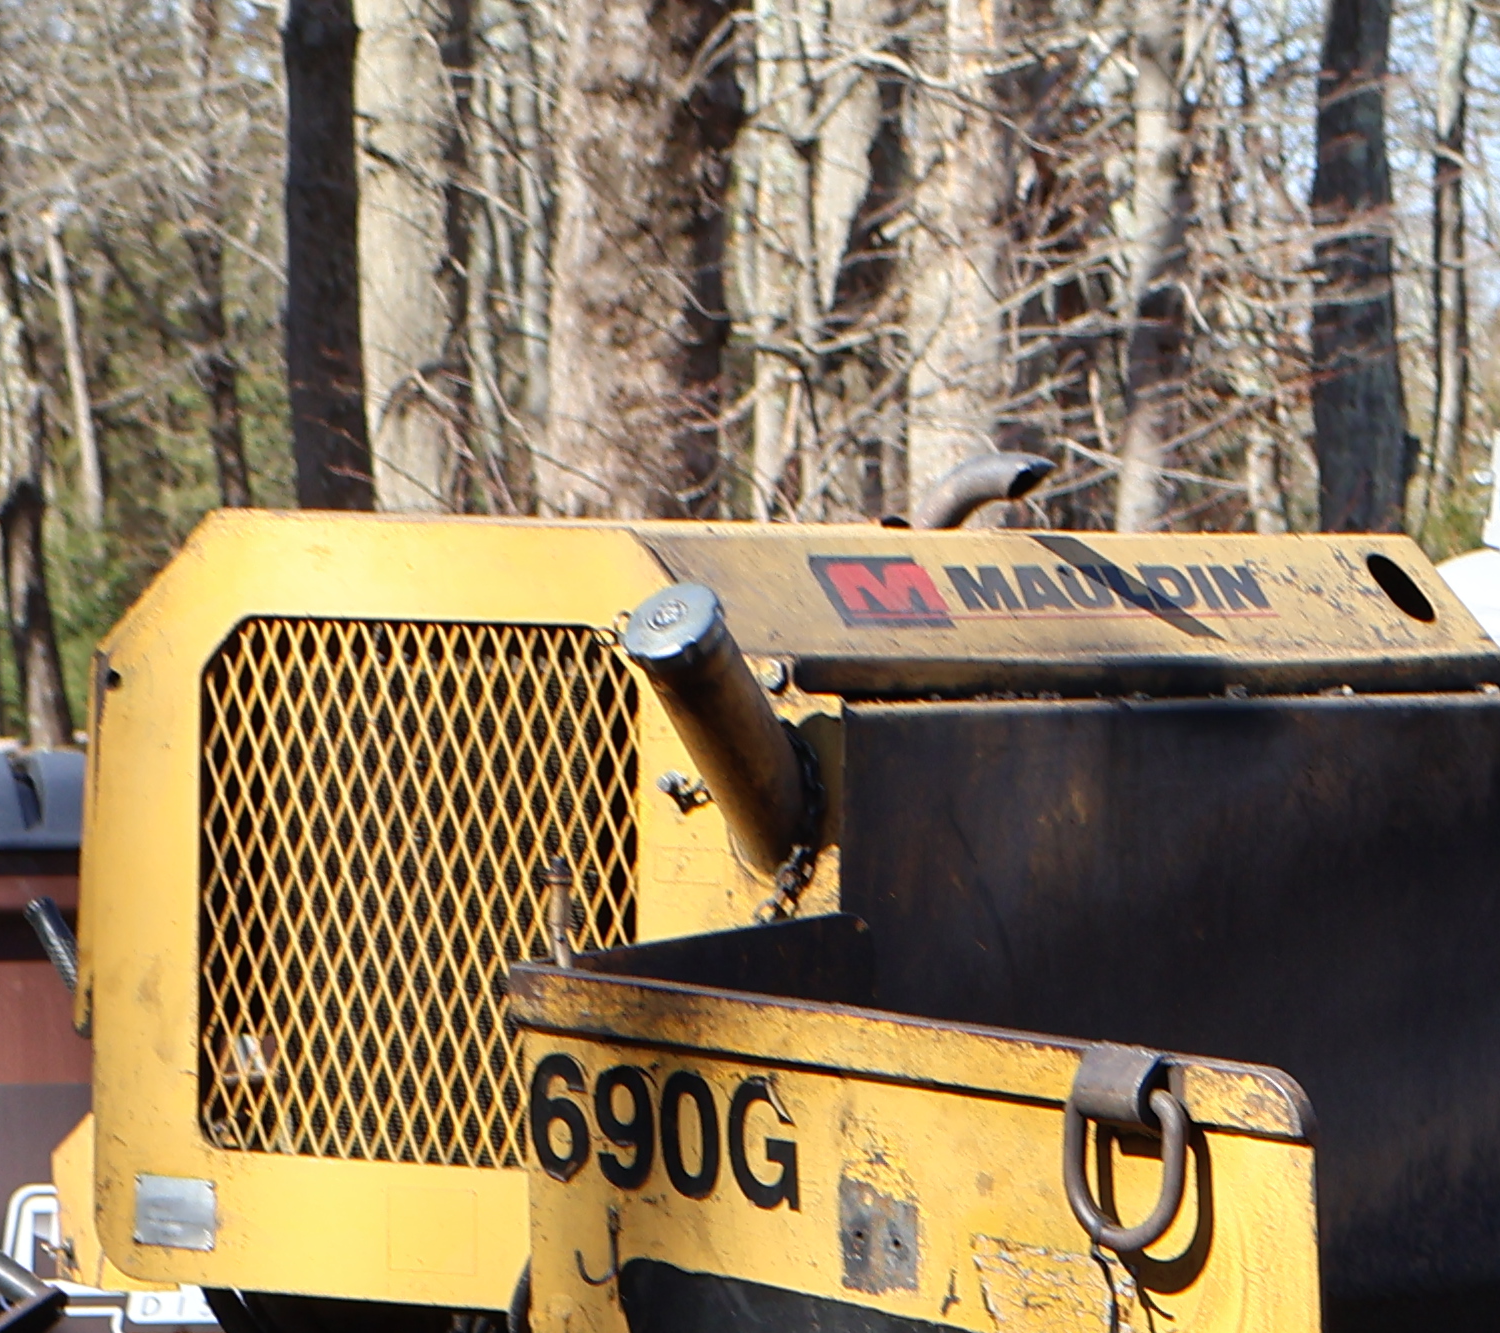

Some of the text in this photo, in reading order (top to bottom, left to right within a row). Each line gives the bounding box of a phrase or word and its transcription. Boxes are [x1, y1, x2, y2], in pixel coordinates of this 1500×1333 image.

[826, 562, 1271, 612] M MAULDIN
[530, 1052, 801, 1212] 690G
